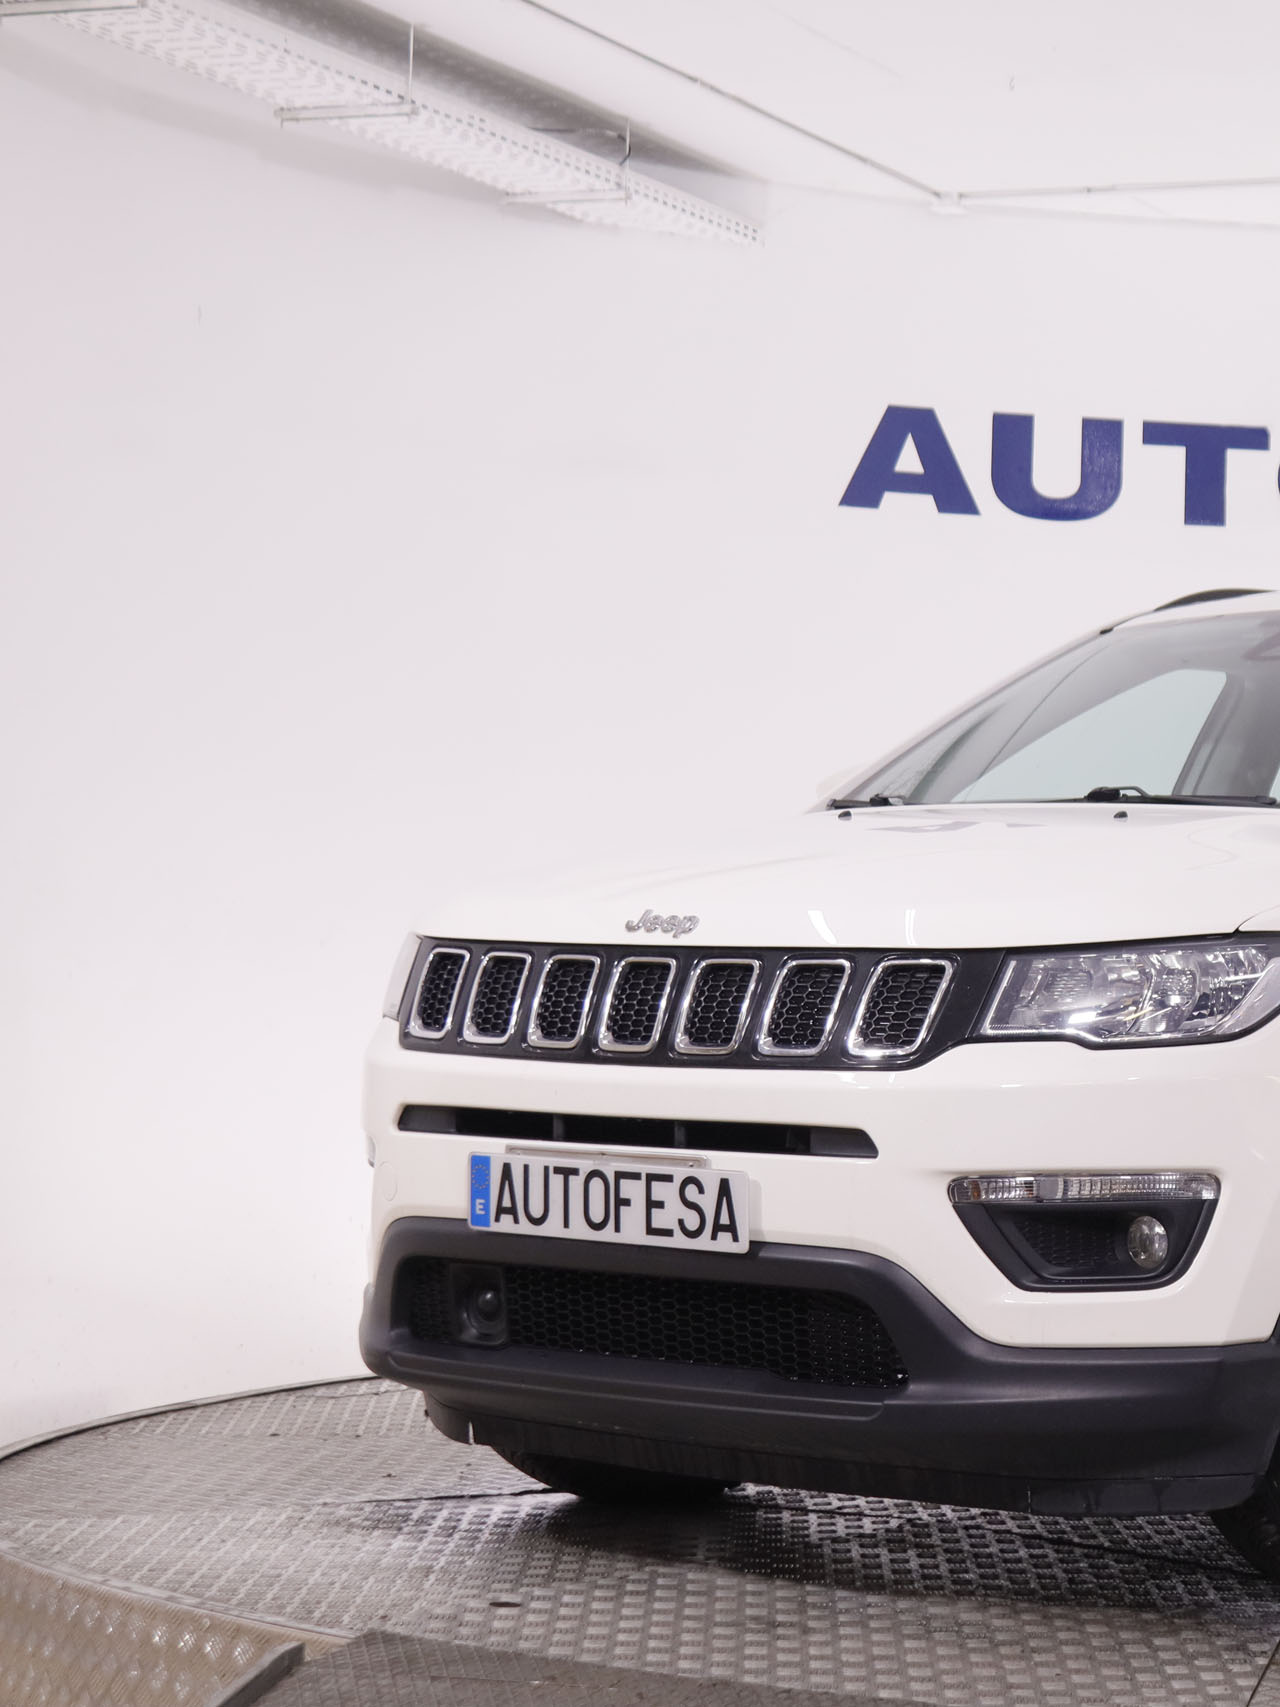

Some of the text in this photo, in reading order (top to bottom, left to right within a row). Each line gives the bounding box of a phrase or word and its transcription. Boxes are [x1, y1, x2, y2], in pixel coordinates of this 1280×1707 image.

[625, 909, 700, 939] Jeep
[475, 1198, 485, 1215] E
[494, 1162, 739, 1243] AUTOFESA
